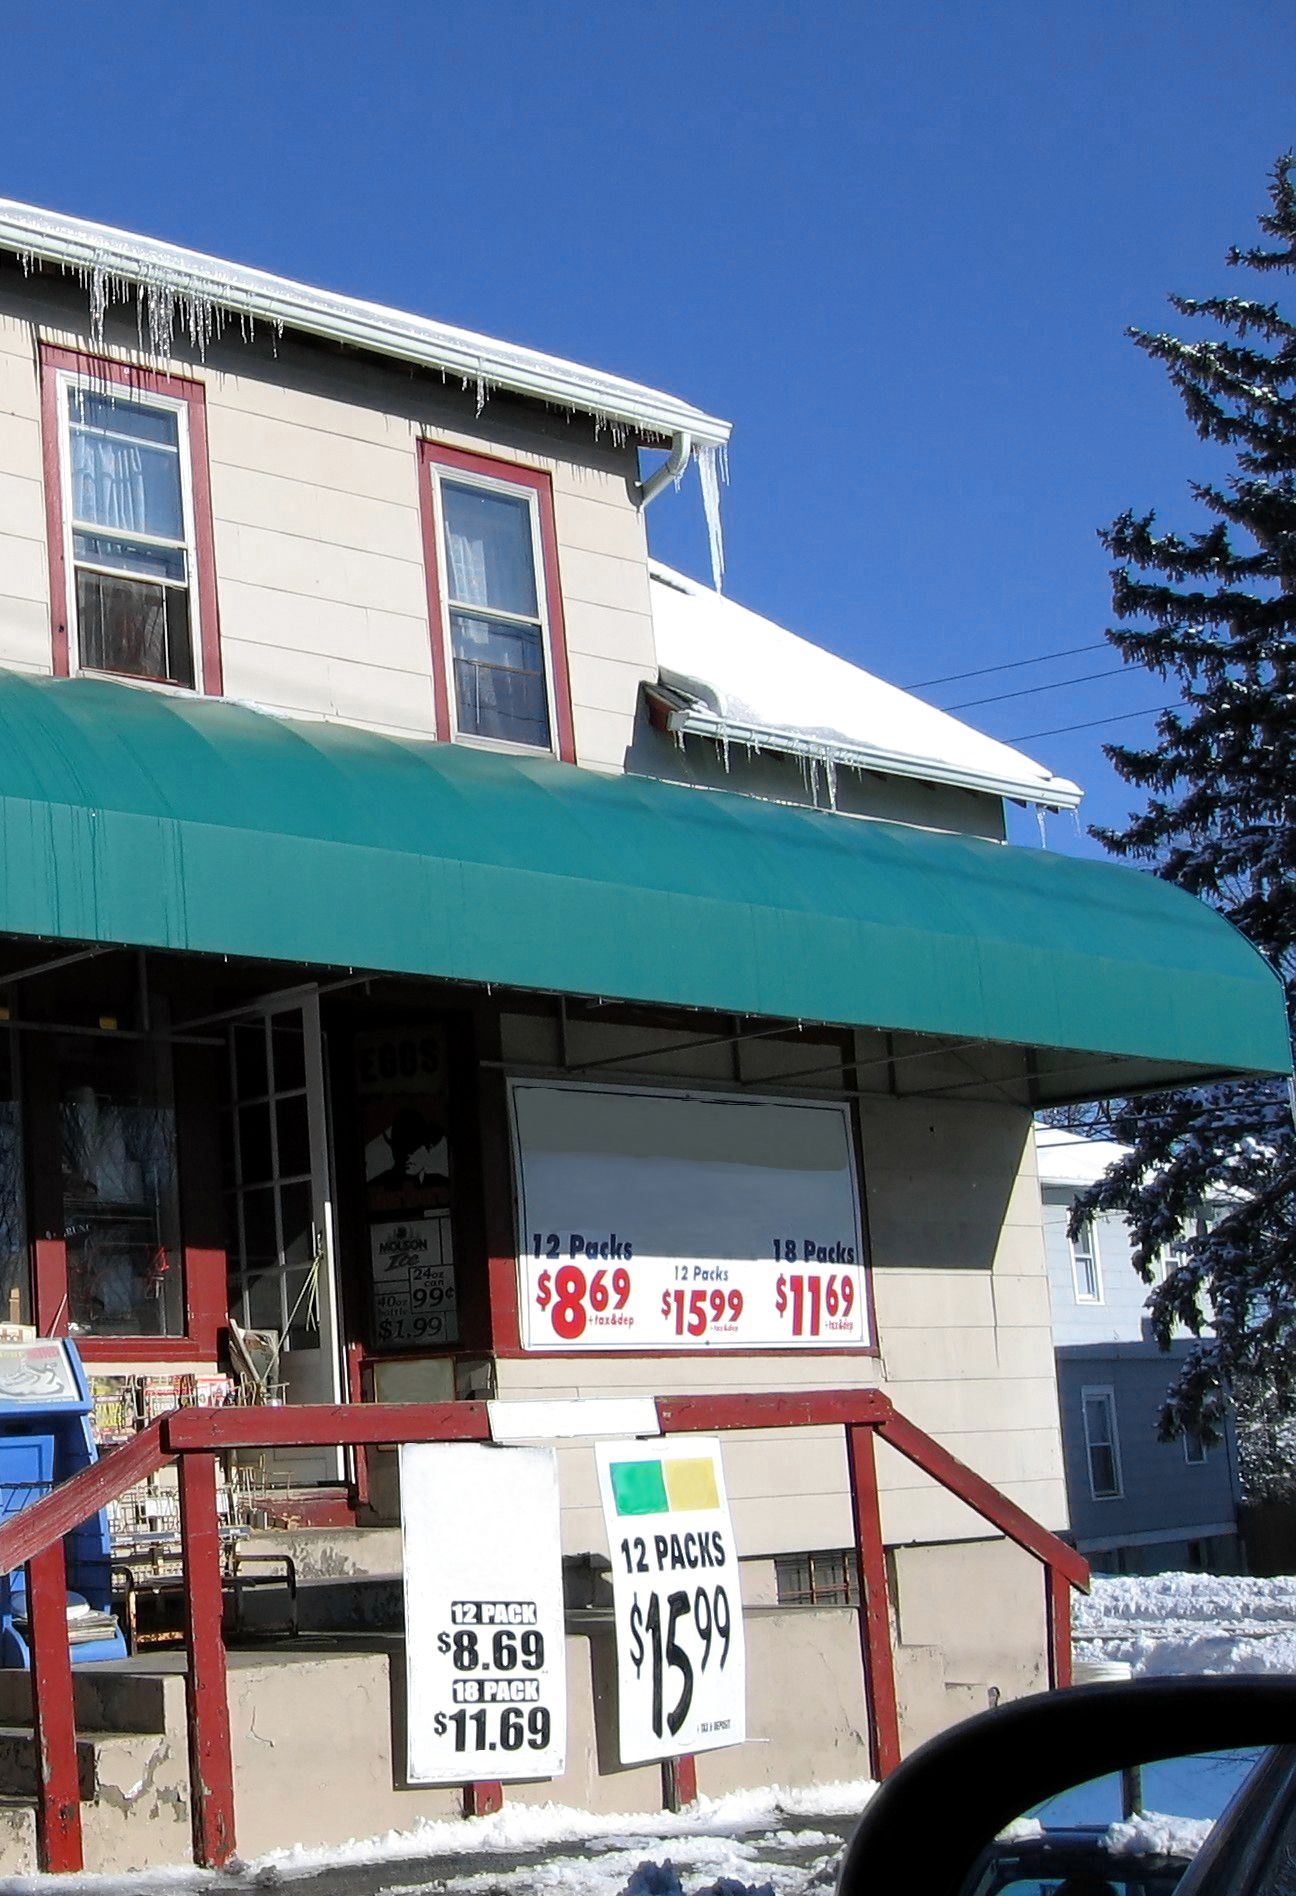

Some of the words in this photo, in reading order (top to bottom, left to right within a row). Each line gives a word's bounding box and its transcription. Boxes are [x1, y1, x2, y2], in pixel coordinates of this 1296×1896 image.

[379, 1239, 428, 1253] MOLSON
[533, 1233, 561, 1259] 12
[570, 1233, 633, 1261] Packs
[773, 1239, 797, 1263] 18
[804, 1239, 855, 1264] Packs
[675, 1265, 689, 1281] 12
[693, 1265, 729, 1282] Packs
[413, 1287, 455, 1308] 99¢
[378, 1316, 443, 1340] $1.99
[621, 1537, 650, 1574] 12
[654, 1530, 726, 1572] PACKS
[452, 1603, 478, 1624] 12
[481, 1603, 537, 1624] PACK
[437, 1629, 545, 1672] $8.69
[453, 1680, 480, 1702] 18
[483, 1680, 540, 1702] PACK
[433, 1706, 551, 1753] $11.69
